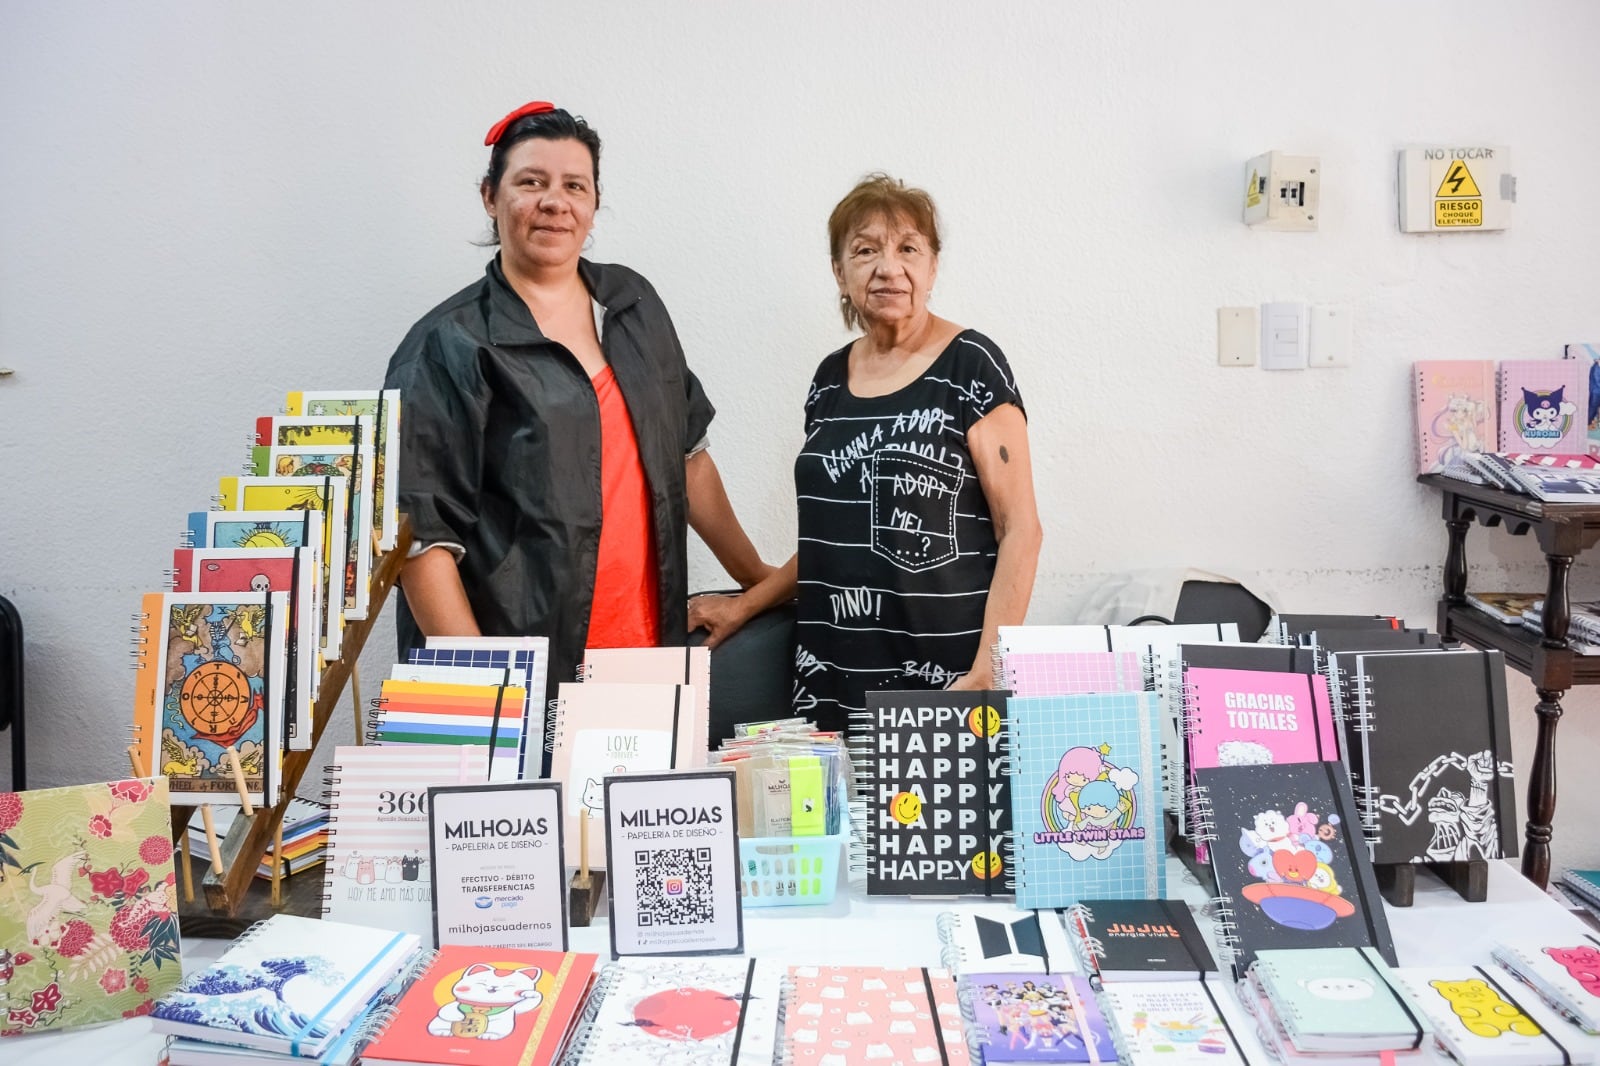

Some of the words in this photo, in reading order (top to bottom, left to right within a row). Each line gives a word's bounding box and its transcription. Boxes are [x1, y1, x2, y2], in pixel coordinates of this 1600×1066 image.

[1424, 149, 1445, 160] NO
[1448, 148, 1494, 160] TOCAR
[1440, 202, 1479, 211] RIESGO
[891, 407, 955, 437] ADOPT
[1525, 430, 1561, 438] KUROMI
[822, 424, 884, 484] WANNA
[893, 471, 948, 500] ADOPT
[890, 506, 923, 537] ME!
[829, 586, 882, 625] DINO!
[1224, 691, 1296, 712] GRACIAS
[878, 707, 971, 728] HAPPY
[1226, 710, 1299, 732] TOTALES
[607, 735, 638, 752] LOVE
[879, 732, 1003, 753] HAPPY
[879, 758, 1003, 778] HAPPY
[620, 806, 722, 828] MILHOJAS
[444, 817, 548, 840] MILHOJAS
[673, 829, 685, 838] DE
[686, 826, 717, 837] DISEÑO
[1034, 831, 1074, 844] LITTLE
[1075, 829, 1108, 842] TWIN
[1109, 827, 1145, 840] STARS
[497, 841, 509, 850] DE
[511, 838, 542, 849] DISEÑO
[879, 834, 1004, 856] HAPPY
[461, 875, 500, 884] EFECTIVO
[880, 860, 973, 881] HAPPY
[366, 887, 377, 902] ME
[380, 887, 396, 902] AMO
[461, 883, 535, 893] TRANSFERENCIAS
[448, 921, 552, 935] milhojascuadernos
